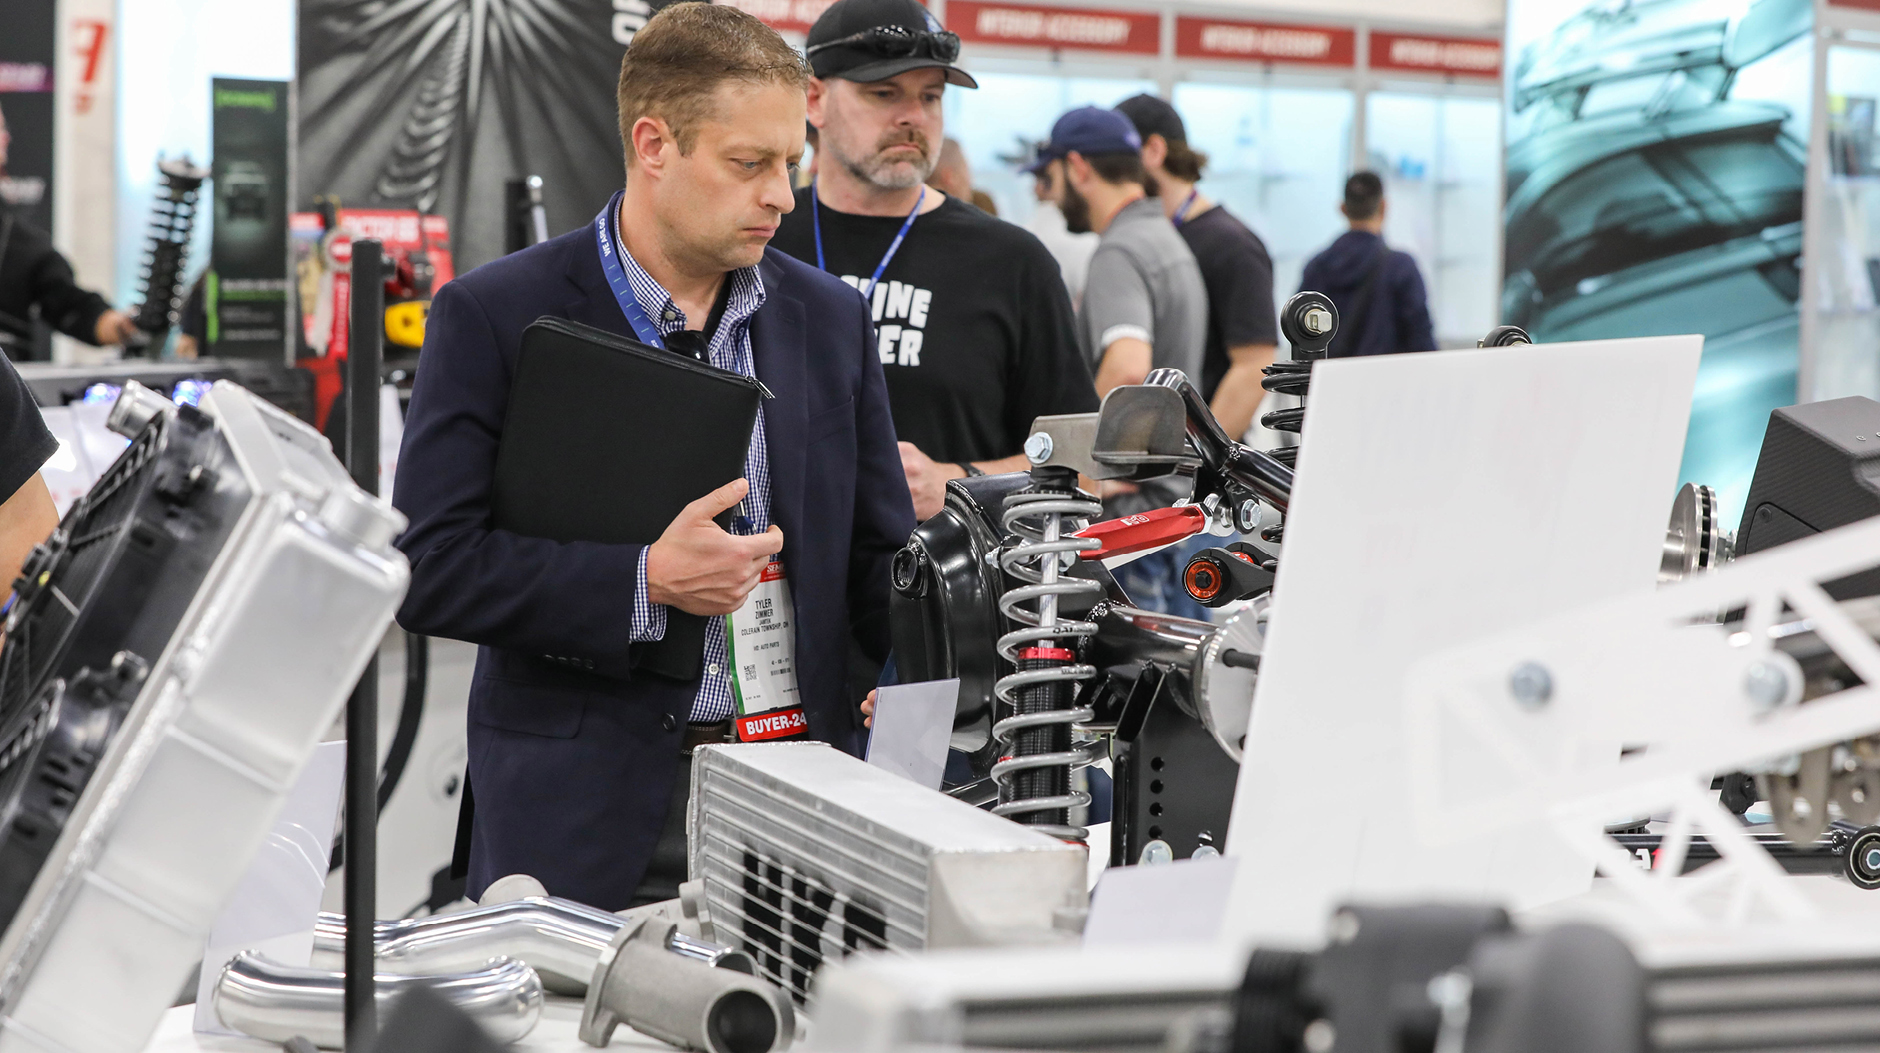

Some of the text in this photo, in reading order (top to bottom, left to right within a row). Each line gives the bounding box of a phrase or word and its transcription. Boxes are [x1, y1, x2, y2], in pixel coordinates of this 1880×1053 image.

[598, 218, 611, 257] WE ARE GO
[755, 598, 772, 610] TYLER
[755, 609, 774, 619] ZIMMER
[741, 627, 760, 636] COLERAIN
[761, 622, 783, 632] TOWNSHIP,
[745, 712, 807, 735] BUYER-24
